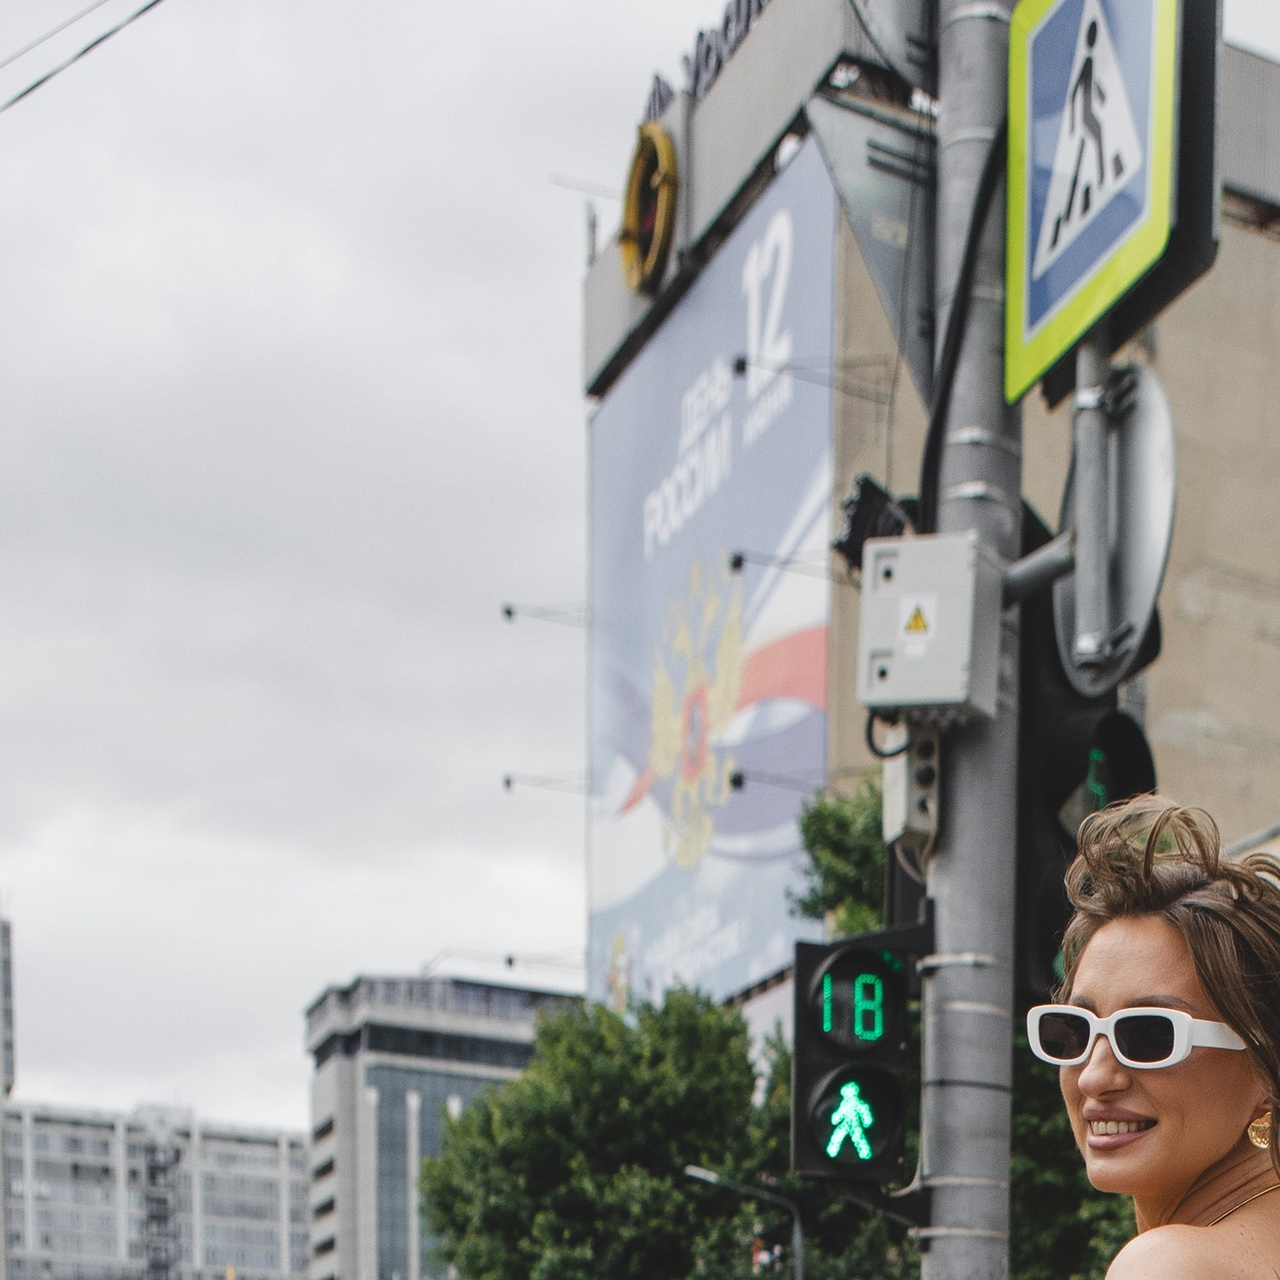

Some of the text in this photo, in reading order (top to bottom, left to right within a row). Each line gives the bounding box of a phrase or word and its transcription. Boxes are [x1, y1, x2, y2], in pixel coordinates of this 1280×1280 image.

[743, 208, 794, 398] 12
[643, 403, 733, 558] РОССИИ
[823, 972, 883, 1041] 18
